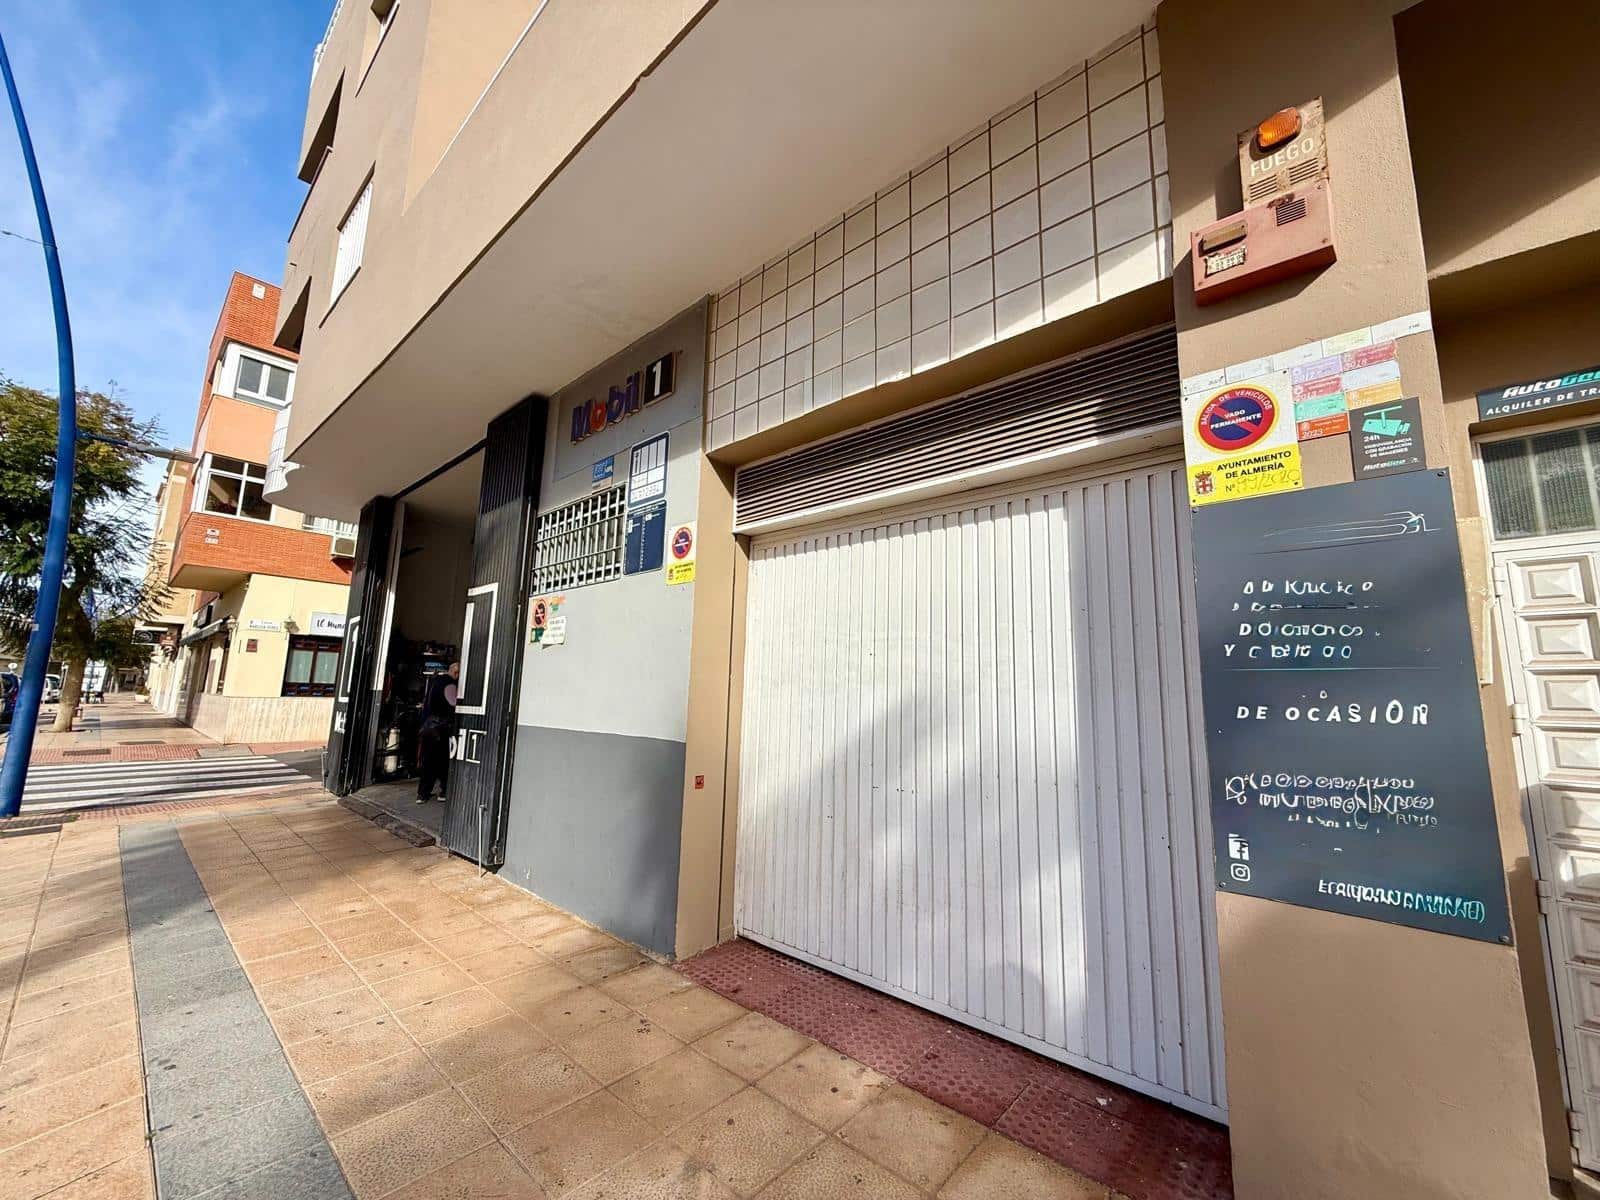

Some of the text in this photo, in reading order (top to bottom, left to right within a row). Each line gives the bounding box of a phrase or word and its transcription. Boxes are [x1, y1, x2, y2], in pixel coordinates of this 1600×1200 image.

[1250, 137, 1314, 177] FUEGO
[571, 371, 640, 445] Mobil
[1486, 397, 1551, 415] ALQUILER
[1557, 392, 1574, 401] DE
[1210, 412, 1262, 429] PERMANENTE
[1224, 409, 1246, 418] VADO
[1217, 450, 1292, 471] AYUNTAMIENTO
[1225, 462, 1285, 479] DE ALMERÍA
[1236, 705, 1268, 720] DE
